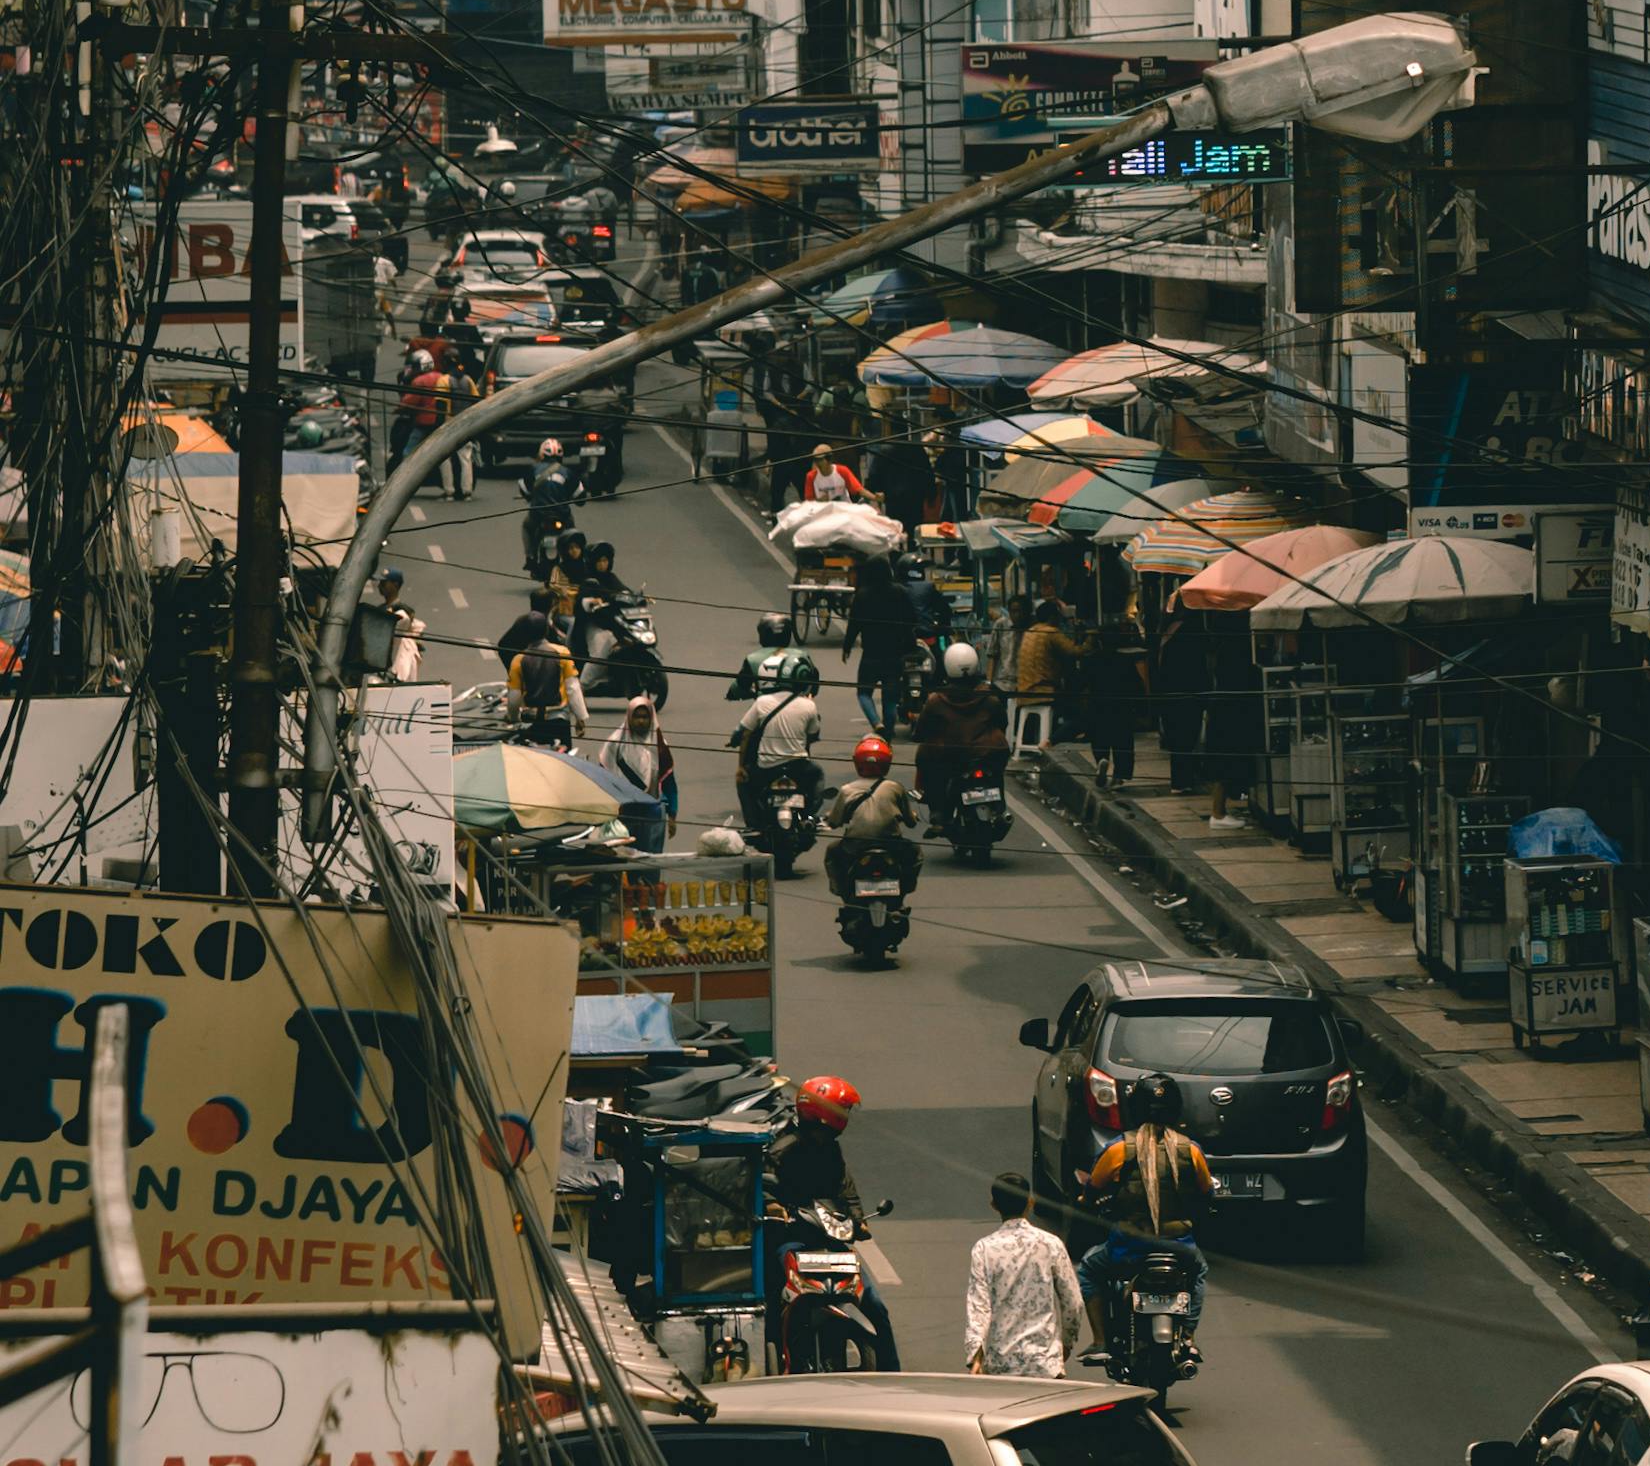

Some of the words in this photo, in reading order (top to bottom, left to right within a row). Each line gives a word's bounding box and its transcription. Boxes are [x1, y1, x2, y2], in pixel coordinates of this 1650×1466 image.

[992, 50, 1028, 60] Abbott
[749, 118, 867, 148] brother
[1418, 519, 1441, 528] VISA
[1531, 975, 1611, 996] SERVICE
[1557, 996, 1598, 1016] JAM
[0, 1156, 181, 1211] APN
[212, 1169, 418, 1227] DJAYA
